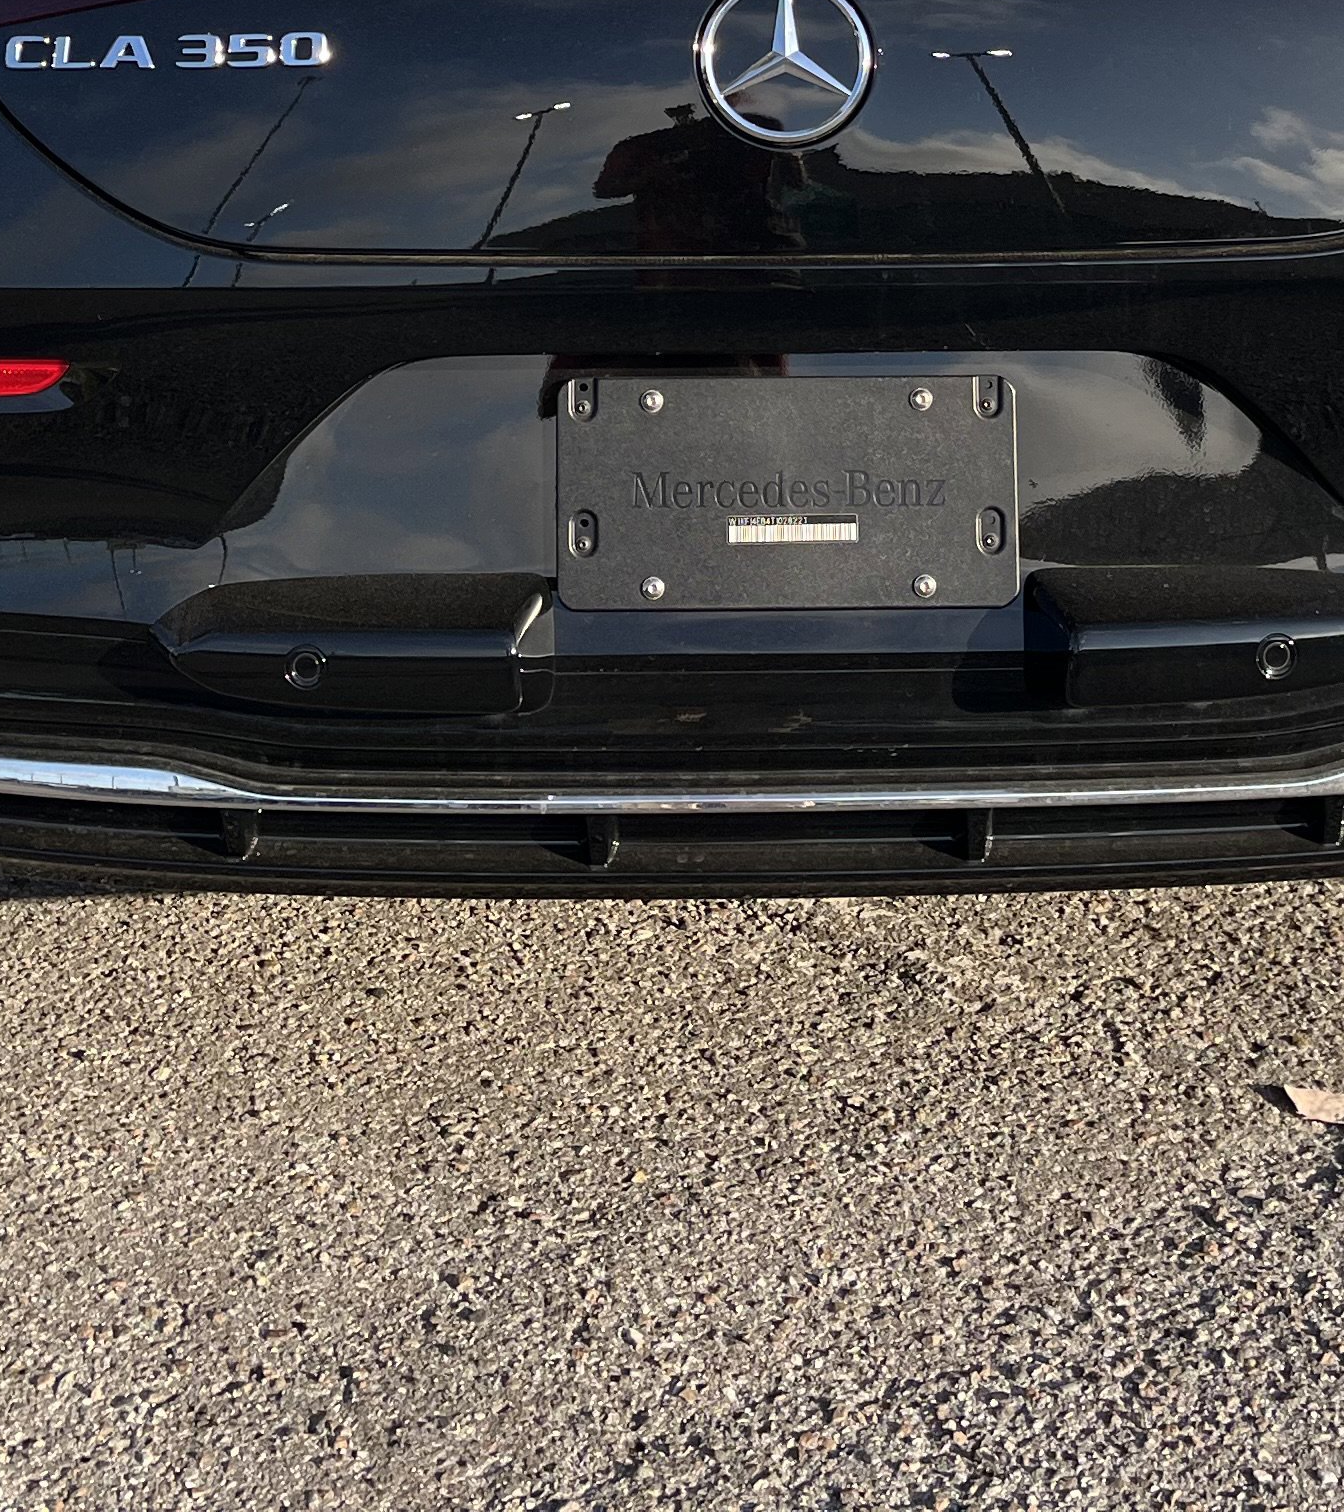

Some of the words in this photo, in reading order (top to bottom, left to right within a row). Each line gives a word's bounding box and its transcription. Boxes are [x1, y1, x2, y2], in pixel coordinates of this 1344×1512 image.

[4, 34, 156, 70] CLA
[175, 31, 331, 69] 350
[630, 468, 947, 510] Mercedes-Benz
